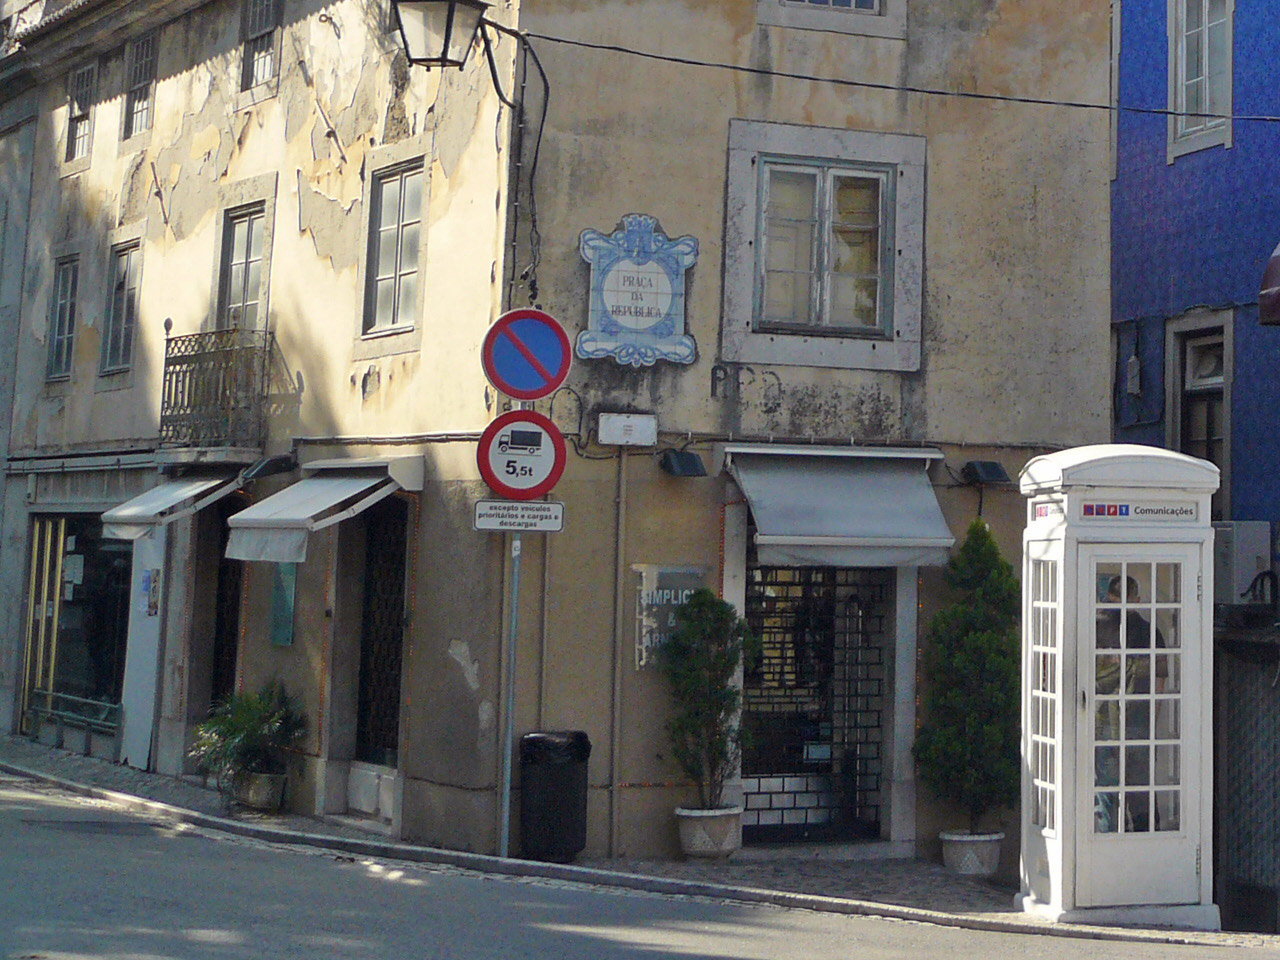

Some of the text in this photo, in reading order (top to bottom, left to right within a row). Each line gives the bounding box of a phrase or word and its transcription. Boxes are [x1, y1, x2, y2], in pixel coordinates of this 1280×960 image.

[623, 275, 653, 289] PRAÇA
[631, 292, 643, 302] DA
[505, 460, 533, 478] 5,5t
[489, 504, 519, 513] excepto
[1134, 506, 1193, 517] Comunicações
[527, 513, 552, 521] cargas
[499, 520, 537, 529] descargas
[641, 589, 695, 605] SIMPLIC
